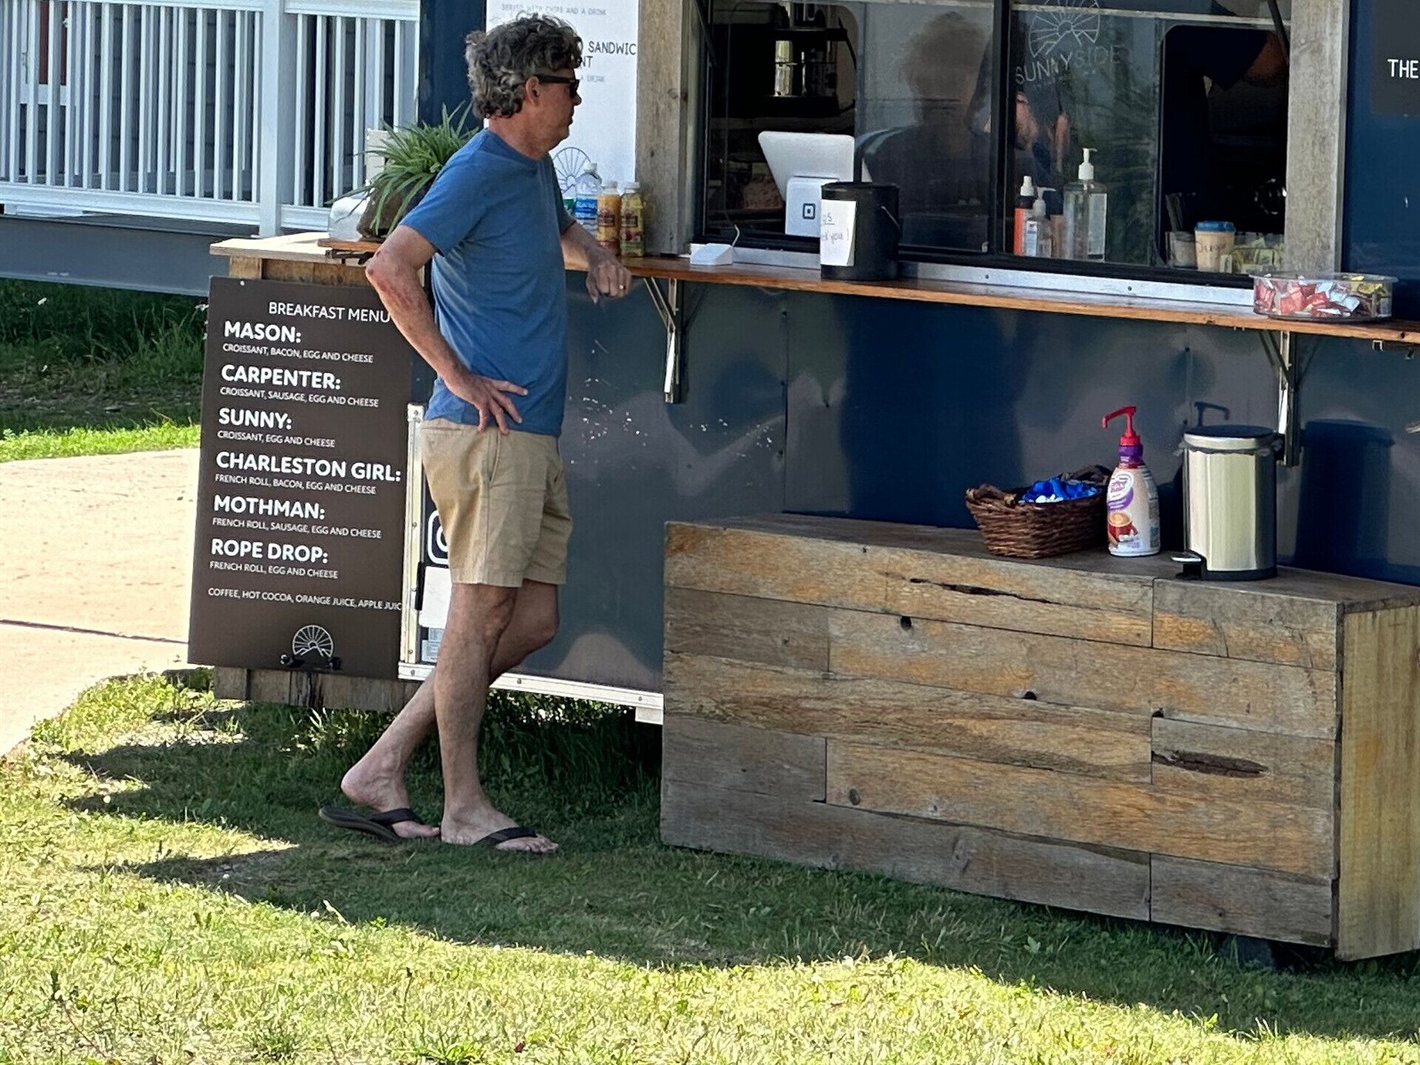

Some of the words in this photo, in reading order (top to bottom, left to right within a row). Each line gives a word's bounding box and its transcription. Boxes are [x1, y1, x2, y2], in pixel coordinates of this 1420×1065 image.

[1388, 59, 1419, 79] THE
[269, 302, 345, 320] BREAKFAST
[349, 308, 390, 323] MENU
[224, 321, 302, 343] MASON:
[222, 343, 270, 356] CROISSANT,
[270, 347, 302, 359] BACON,
[303, 350, 320, 360] EGG
[322, 351, 340, 361] AND
[342, 353, 373, 363] CHEESE
[221, 365, 341, 390] CARPENTER:
[220, 387, 267, 400] CROISSANT,
[268, 391, 307, 403] SAUSAGE,
[308, 394, 326, 404] EGG
[327, 395, 346, 405] AND
[348, 397, 379, 408] CHEESE
[218, 408, 292, 430] SUNNY:
[217, 431, 264, 444] CROISSANT,
[266, 435, 283, 444] EGG
[284, 436, 303, 446] AND
[304, 438, 335, 448] CHEESE
[216, 451, 347, 478] CHARLESTON
[351, 463, 401, 482] GIRL:
[215, 474, 248, 485] FRENCH
[273, 479, 304, 490] BACON,
[306, 481, 323, 491] EGG
[324, 483, 342, 493] AND
[343, 484, 376, 495] CHEESE
[214, 495, 325, 520] MOTHMAN:
[212, 517, 245, 528] FRENCH
[246, 520, 269, 531] ROLL,
[271, 522, 310, 534] SAUSAGE,
[311, 525, 329, 535] EGG
[330, 527, 349, 536] AND
[350, 529, 382, 539] CHEESE
[212, 538, 264, 559] ROPE
[268, 543, 328, 564] DROP:
[210, 561, 242, 571] FRENCH
[244, 563, 266, 574] ROLL,
[268, 565, 286, 575] EGG
[287, 567, 305, 577] AND
[307, 569, 338, 579] CHEESE
[208, 588, 240, 599] COFFEE,
[242, 590, 260, 599] HOT
[262, 592, 294, 603] COCOA,
[296, 595, 331, 606] ORANGE
[358, 599, 382, 610] APPLE
